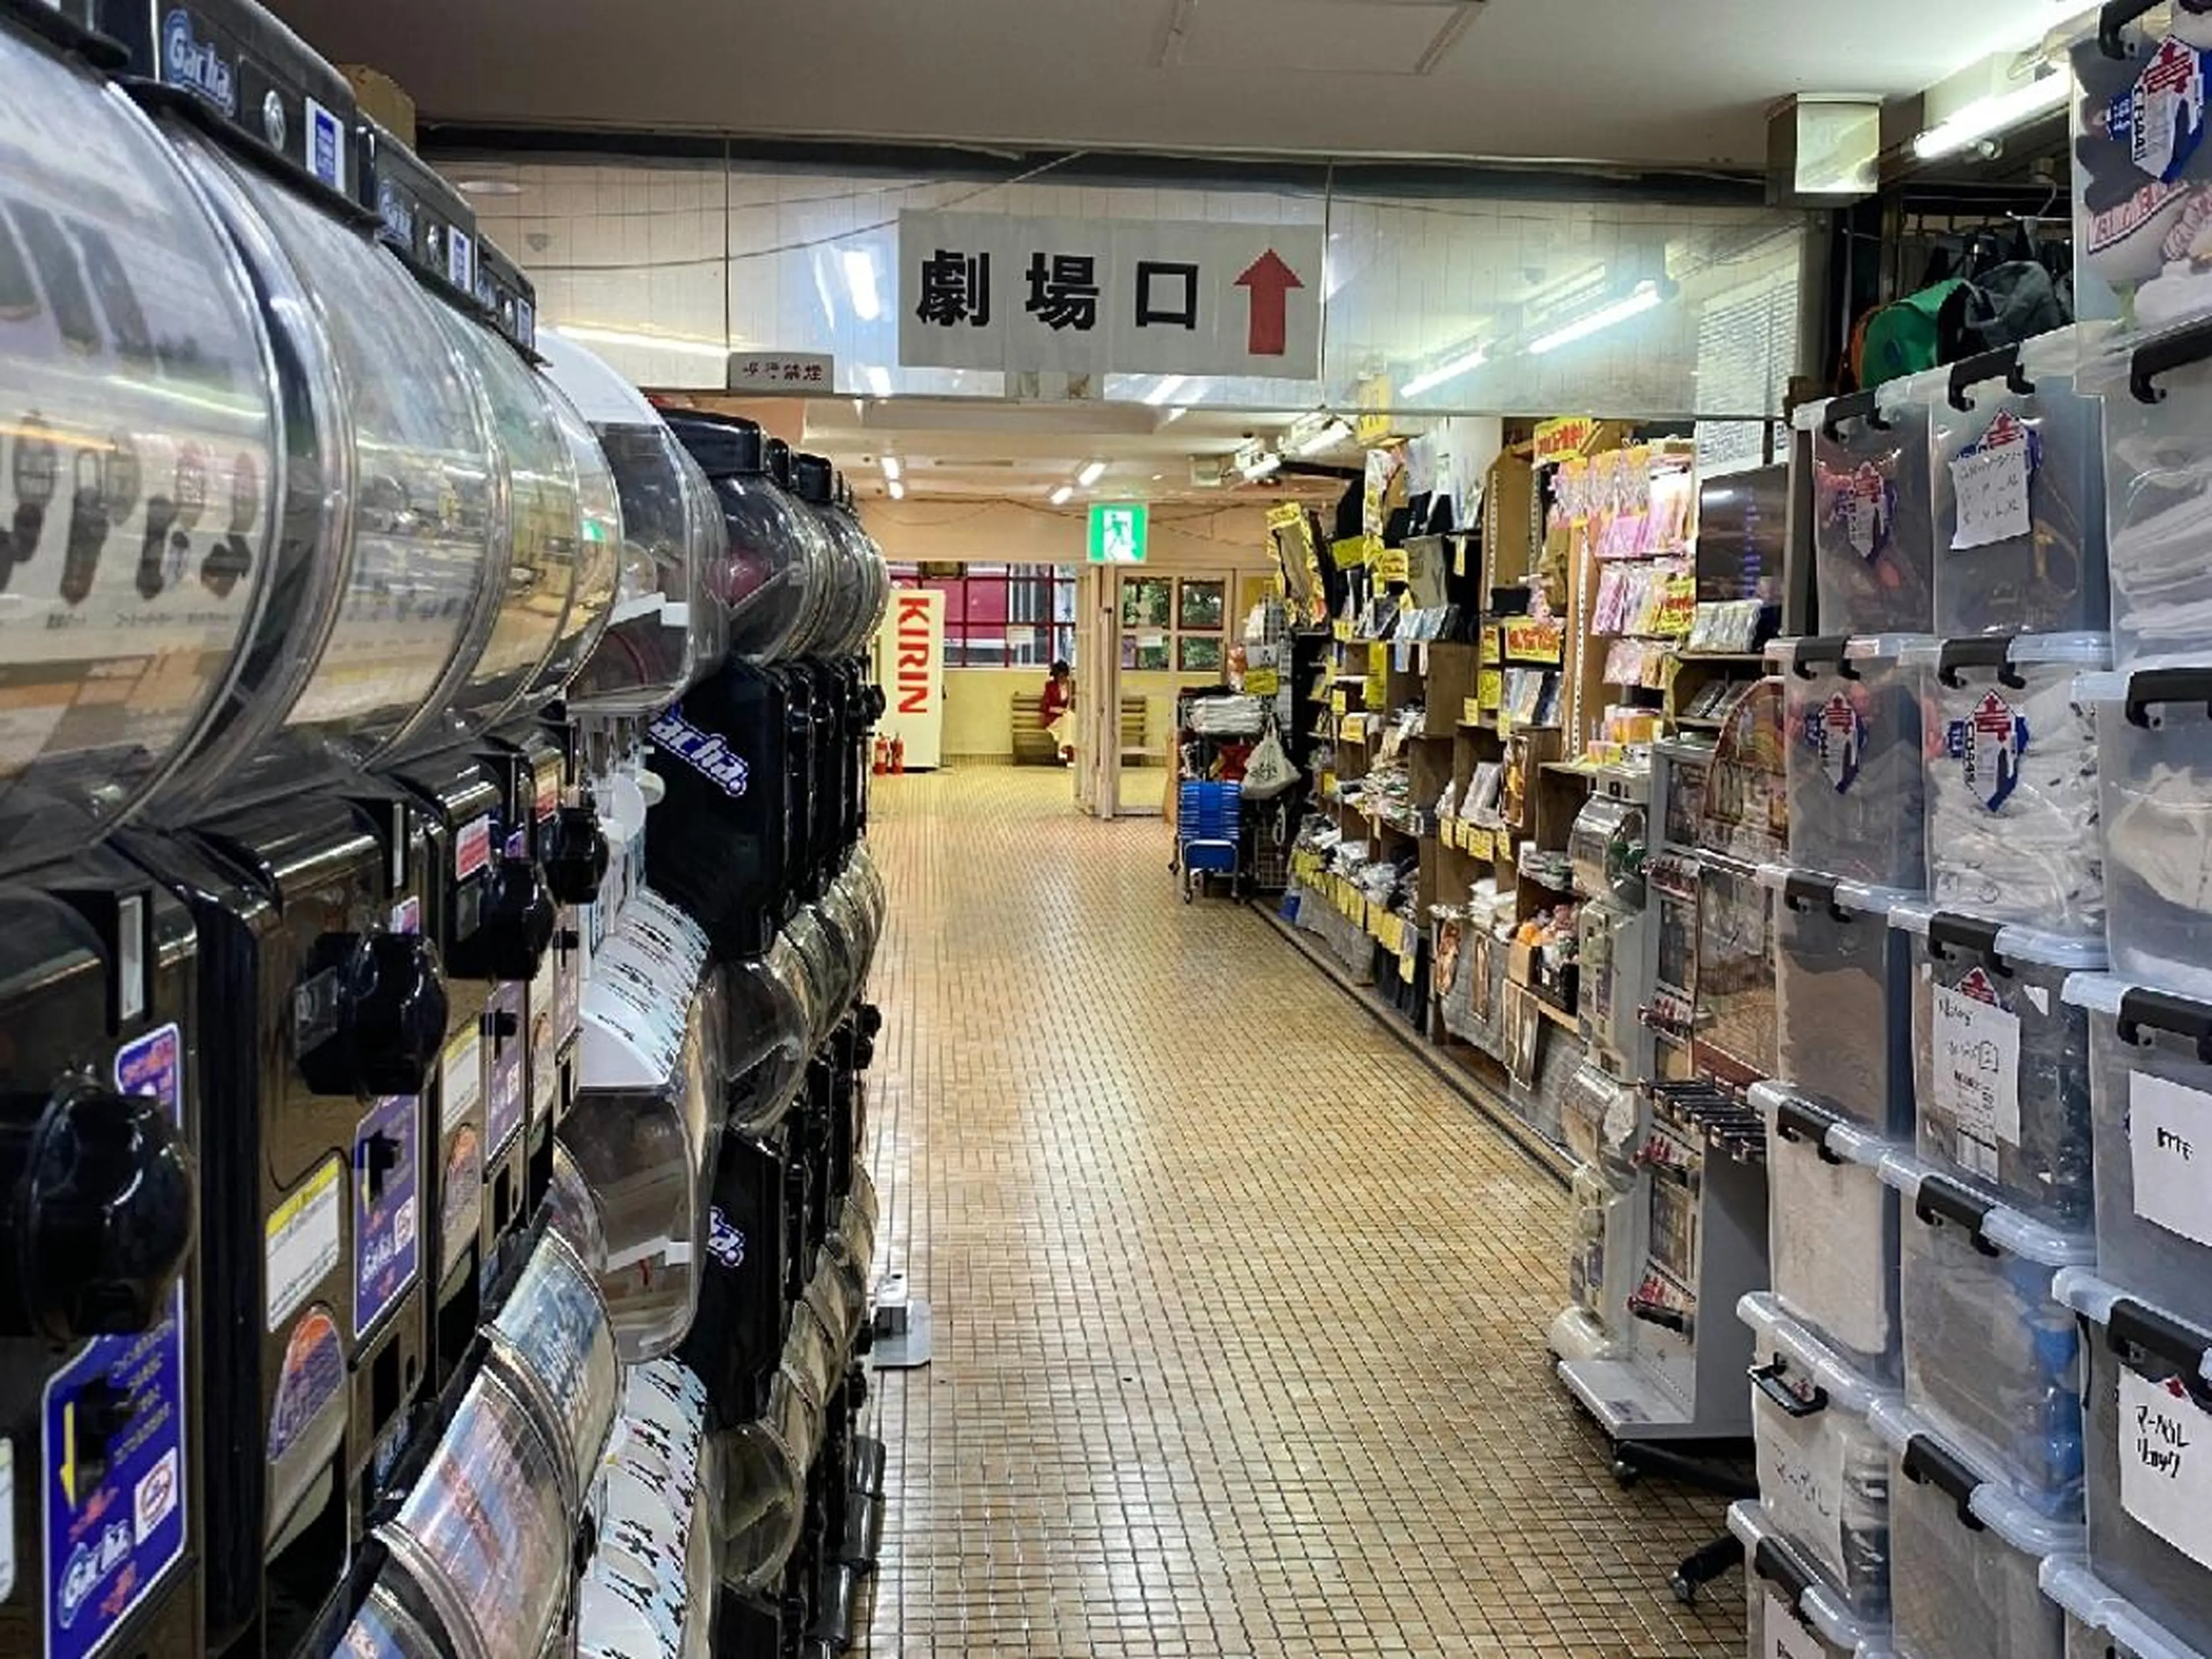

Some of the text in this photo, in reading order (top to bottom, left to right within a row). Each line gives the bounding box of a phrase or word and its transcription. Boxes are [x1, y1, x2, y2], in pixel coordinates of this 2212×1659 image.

[916, 249, 1200, 330] 劇場口
[896, 597, 930, 714] KIRIN
[648, 706, 748, 796] acha
